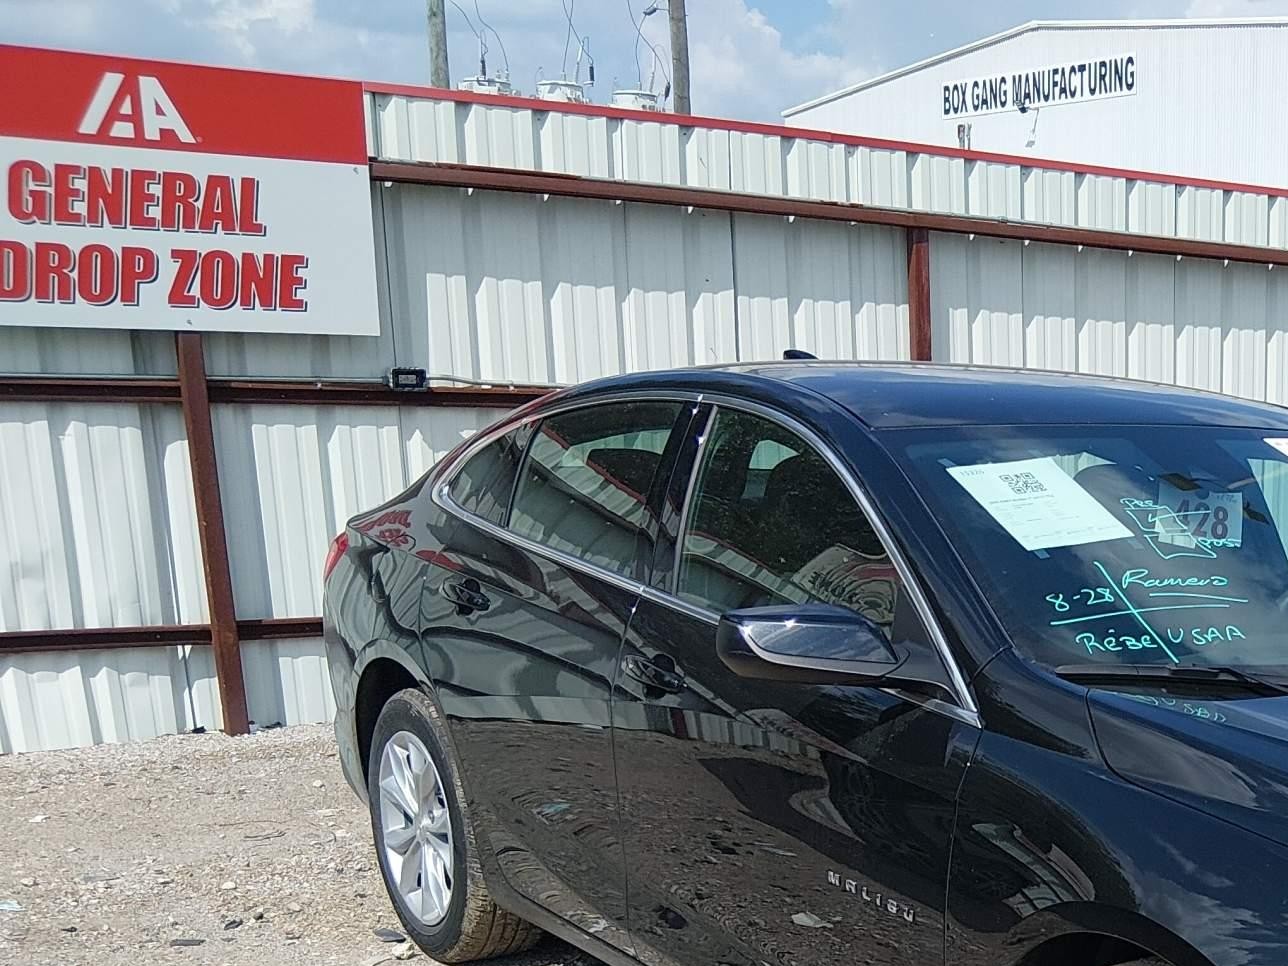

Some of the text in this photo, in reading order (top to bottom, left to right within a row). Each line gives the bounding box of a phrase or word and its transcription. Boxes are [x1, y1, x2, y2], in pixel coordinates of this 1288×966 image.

[943, 56, 1136, 115] BOX GANG MANUFACTURING
[8, 160, 267, 236] GENERAL
[0, 240, 308, 312] DROP ZONE
[1175, 498, 1230, 540] 428
[827, 870, 915, 922] MALIBU
